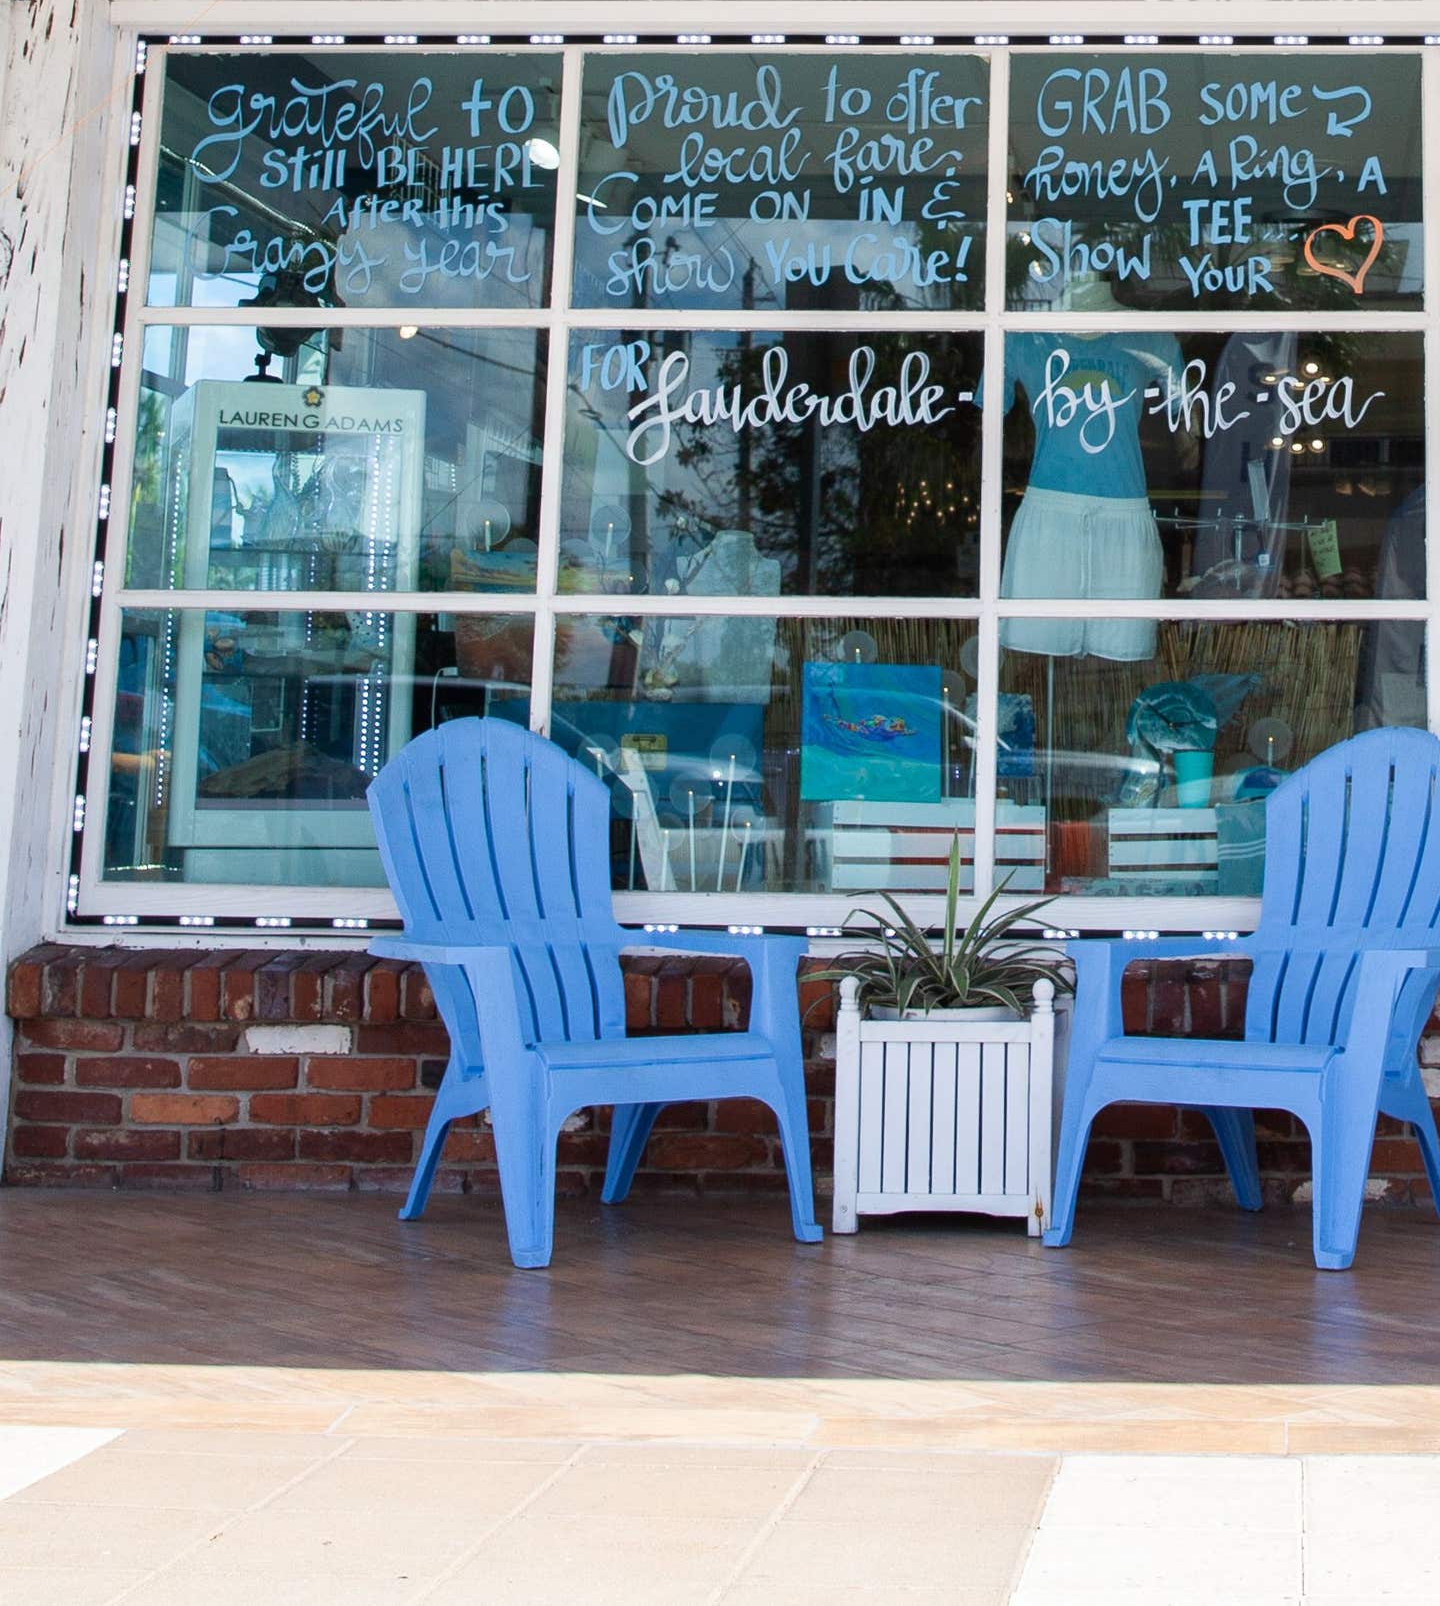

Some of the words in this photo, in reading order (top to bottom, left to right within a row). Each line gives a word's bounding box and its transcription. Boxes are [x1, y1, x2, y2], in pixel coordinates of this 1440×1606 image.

[1037, 67, 1171, 137] GRAB
[377, 145, 429, 188] BE
[440, 143, 545, 193] HERE
[1192, 150, 1218, 188] A
[1357, 156, 1388, 195] A
[750, 189, 810, 225] ON
[581, 340, 652, 395] FOR
[219, 409, 299, 429] LAUREN
[302, 414, 320, 429] G
[324, 416, 405, 433] ADAMS
